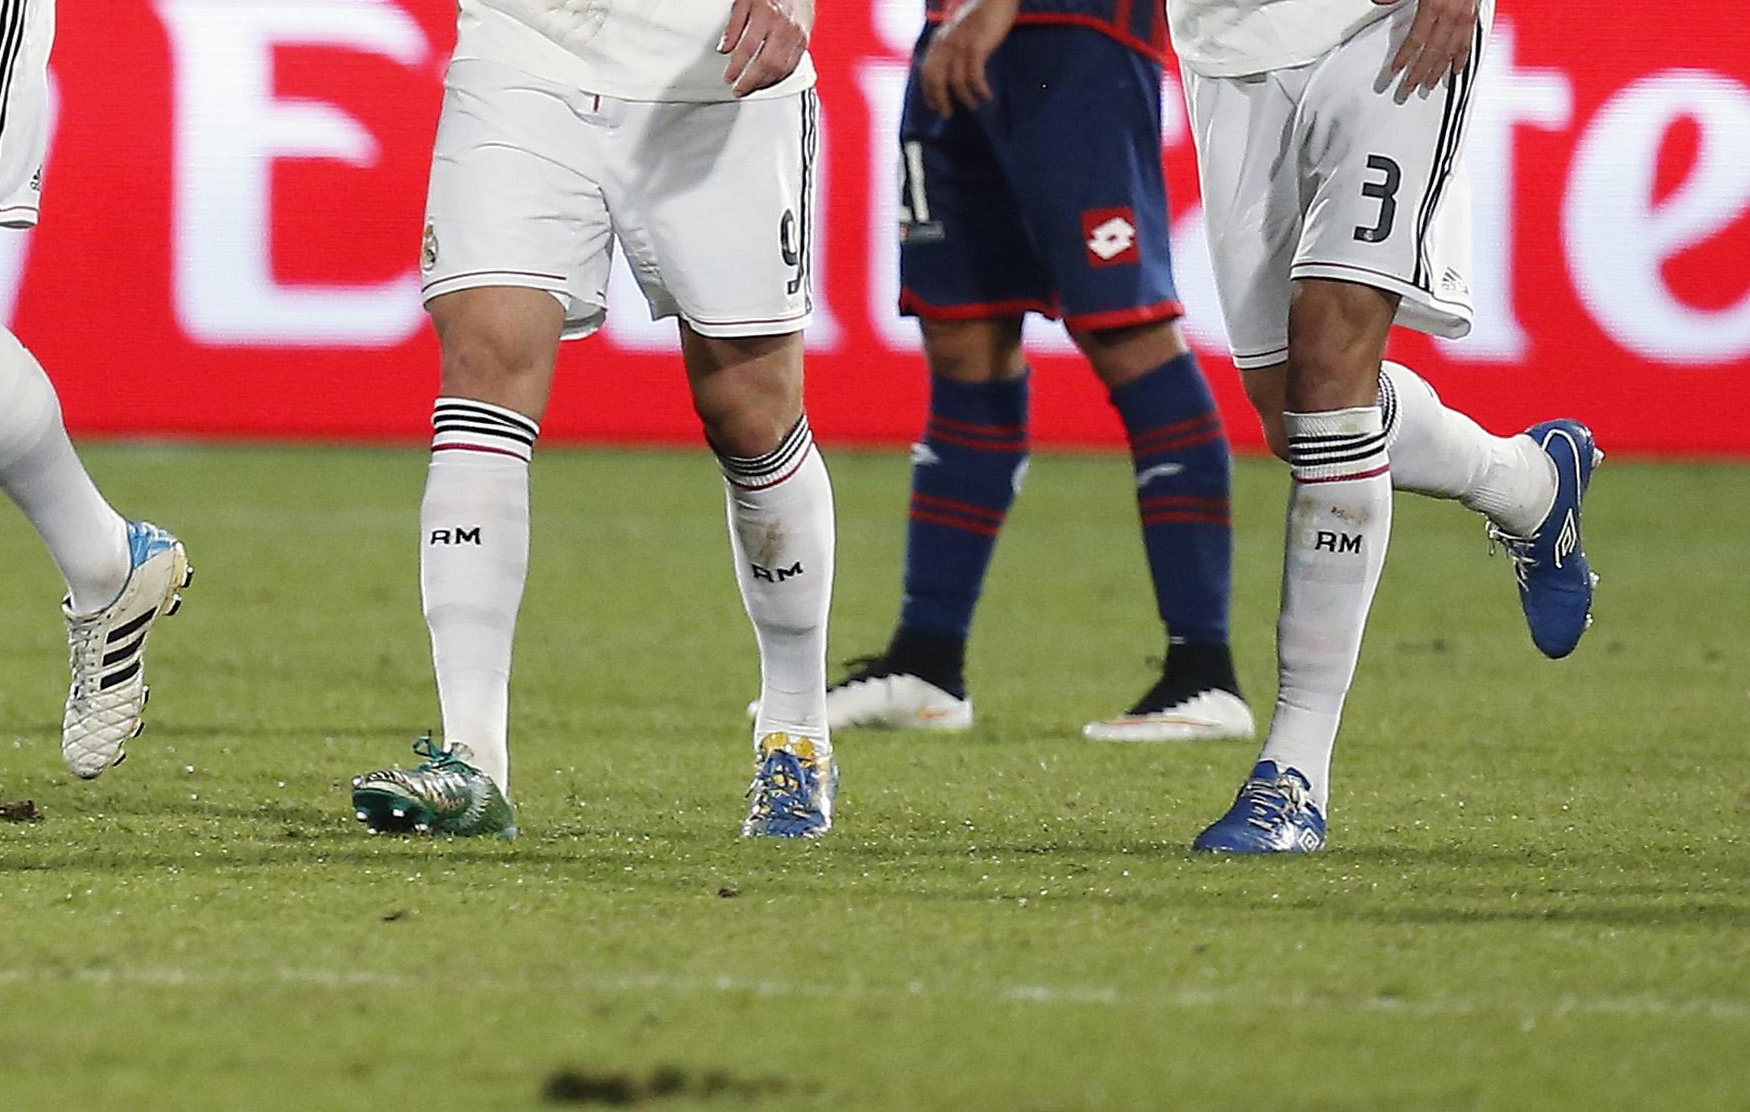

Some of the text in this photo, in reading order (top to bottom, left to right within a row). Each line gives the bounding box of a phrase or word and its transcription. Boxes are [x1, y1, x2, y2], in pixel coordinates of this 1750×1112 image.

[1354, 154, 1401, 243] 3
[430, 527, 481, 545] RM
[1315, 531, 1362, 554] RM
[751, 561, 803, 583] RM
